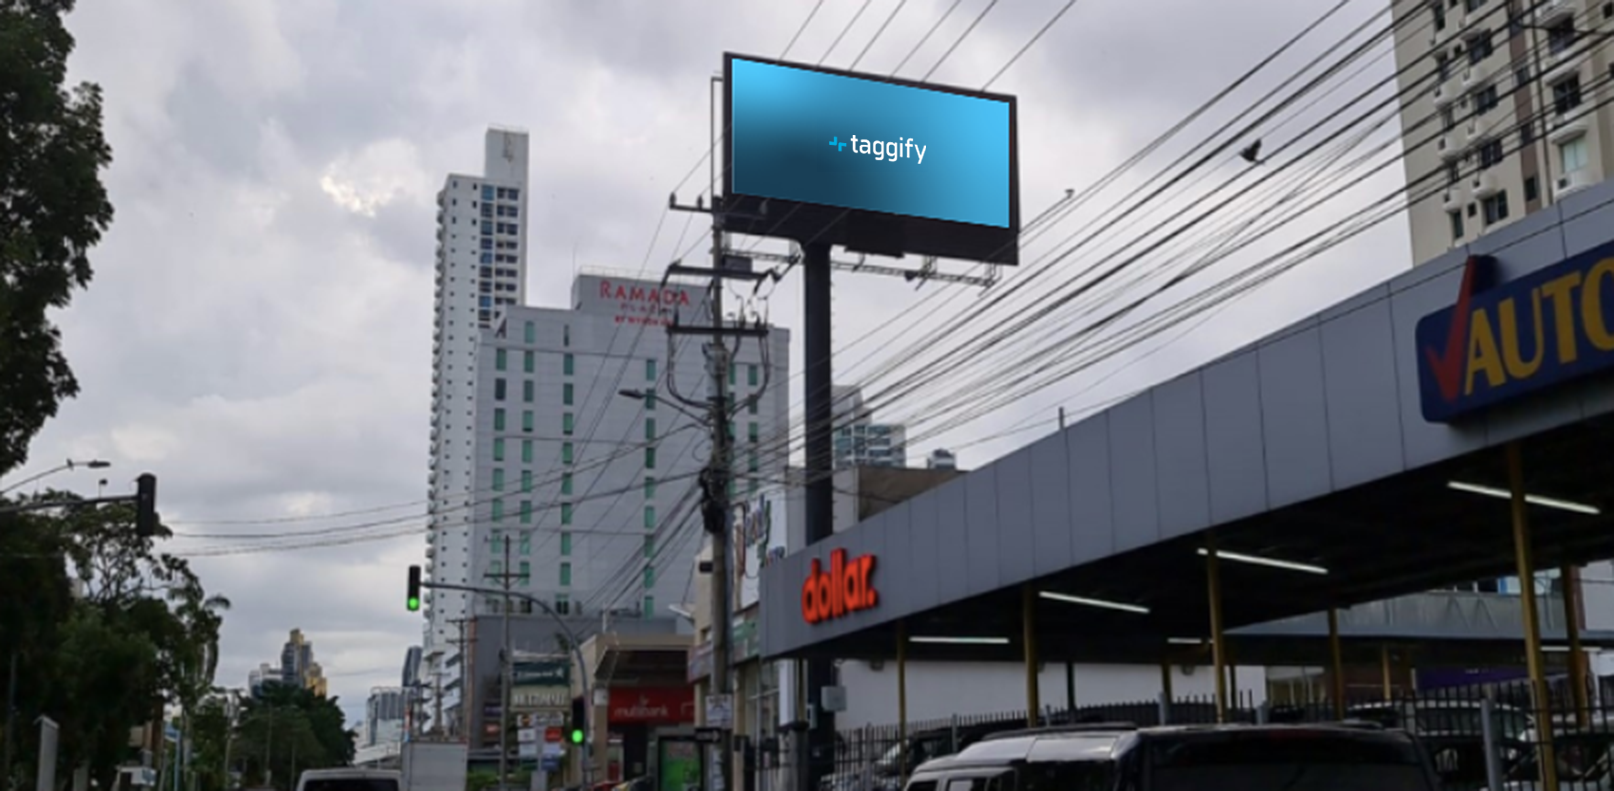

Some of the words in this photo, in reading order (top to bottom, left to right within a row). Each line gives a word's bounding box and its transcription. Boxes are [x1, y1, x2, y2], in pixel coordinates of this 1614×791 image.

[850, 134, 927, 165] taggify
[601, 280, 689, 306] RAMADA
[801, 547, 879, 625] dollar.
[614, 704, 669, 718] multibank
